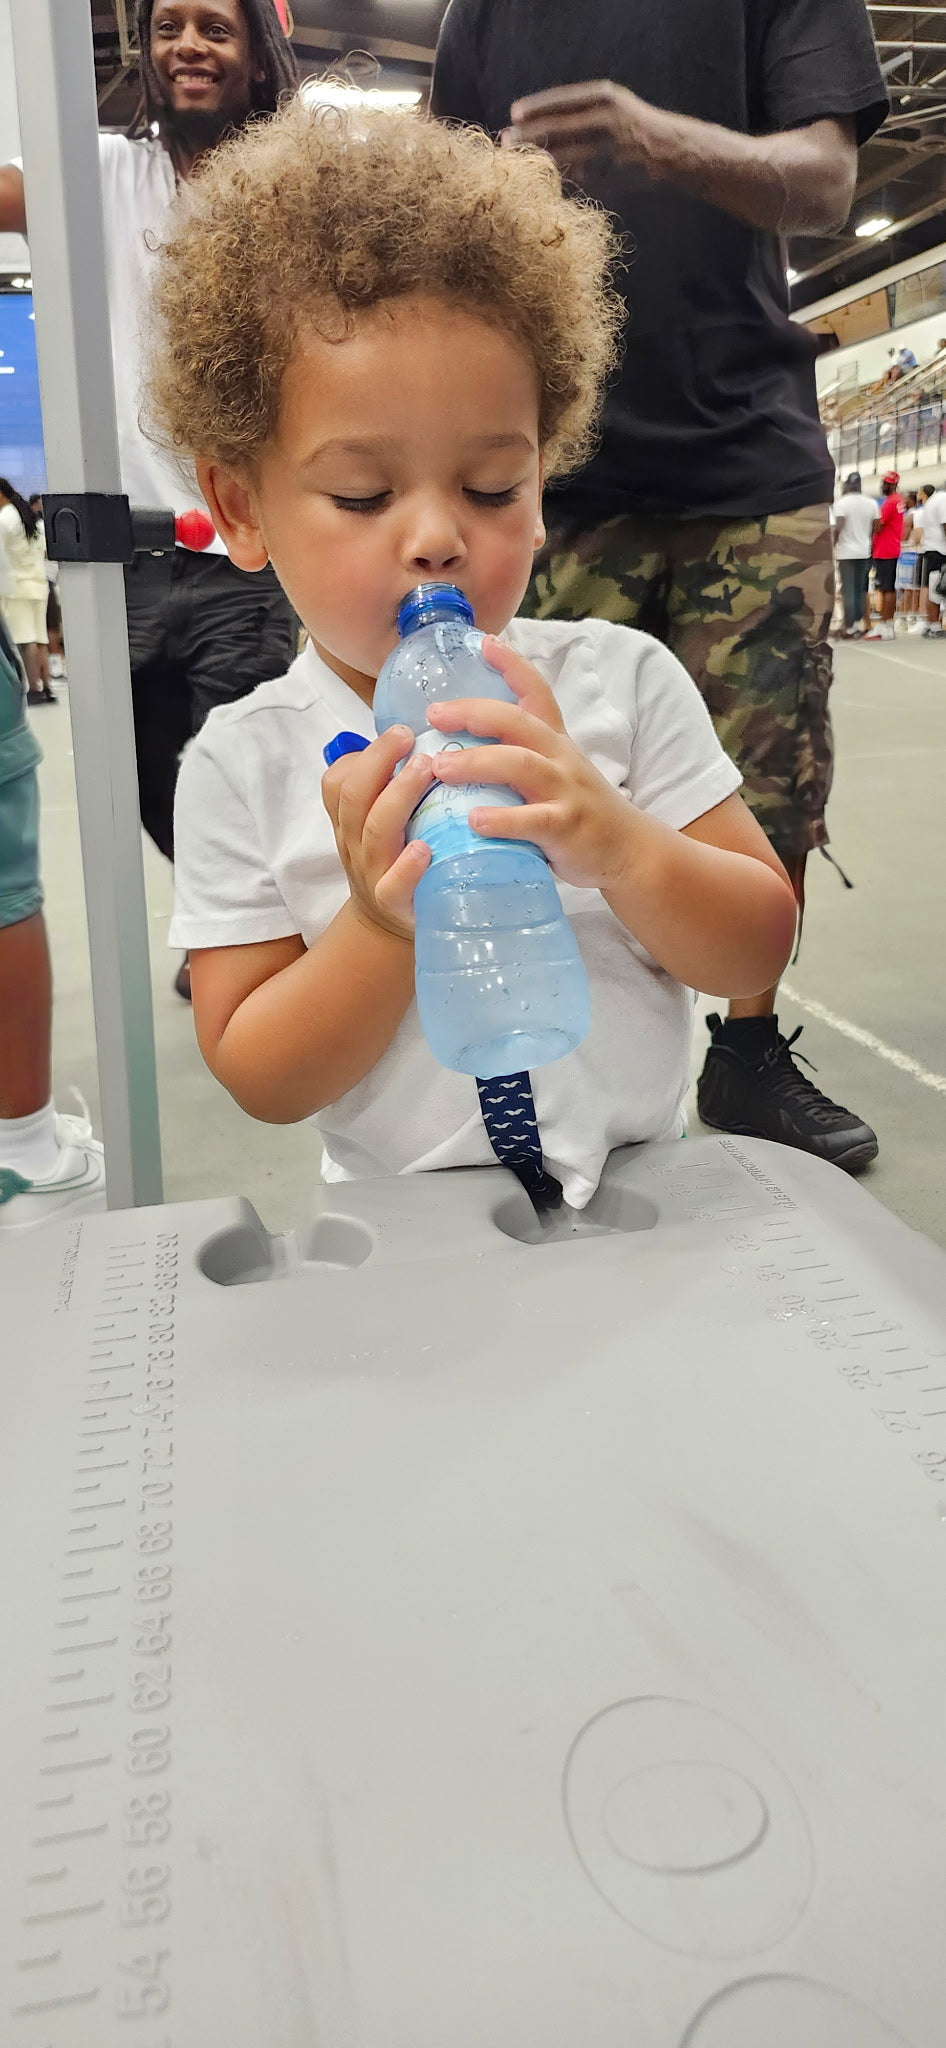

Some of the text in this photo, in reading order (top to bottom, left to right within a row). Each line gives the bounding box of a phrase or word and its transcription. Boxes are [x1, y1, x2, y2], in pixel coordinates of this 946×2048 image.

[147, 1322, 175, 1344] 80
[146, 1349, 174, 1373] 78
[837, 1364, 883, 1390] 28
[145, 1378, 174, 1402] 76
[868, 1407, 921, 1434] 27
[140, 1442, 174, 1474] 72
[136, 1481, 174, 1513] 70
[136, 1519, 173, 1556] 68
[133, 1564, 173, 1604] 66
[130, 1611, 172, 1657] 64
[127, 1663, 172, 1714] 62
[124, 1726, 172, 1779] 60
[122, 1789, 173, 1849] 58
[119, 1864, 173, 1928] 56
[115, 1948, 173, 2022] 54
